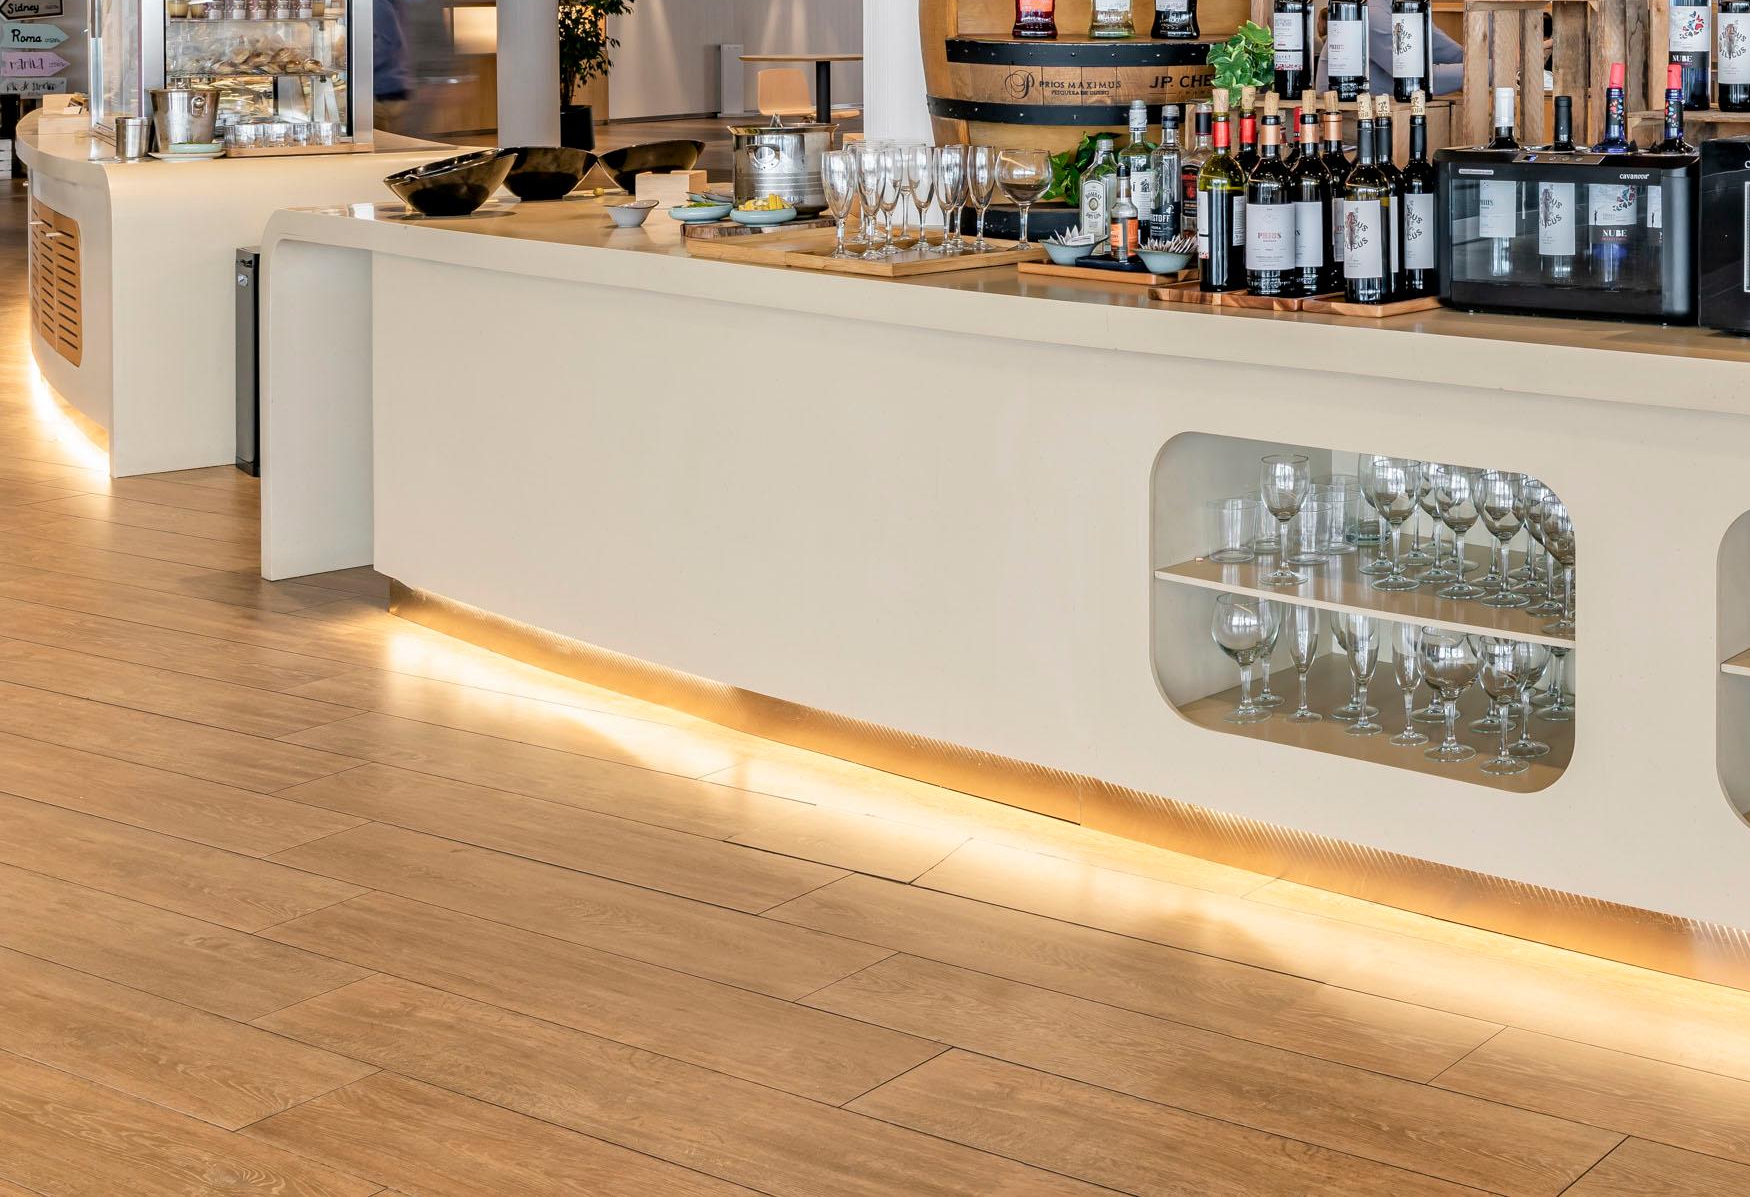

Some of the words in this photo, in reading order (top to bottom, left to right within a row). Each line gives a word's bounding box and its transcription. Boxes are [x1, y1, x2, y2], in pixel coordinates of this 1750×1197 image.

[7, 3, 39, 14] Sidney
[11, 29, 42, 43] Roma
[1672, 55, 1693, 63] NUBE
[1067, 81, 1121, 89] MAXIMUS
[1151, 214, 1171, 222] STOFF
[1602, 229, 1627, 237] NUBE
